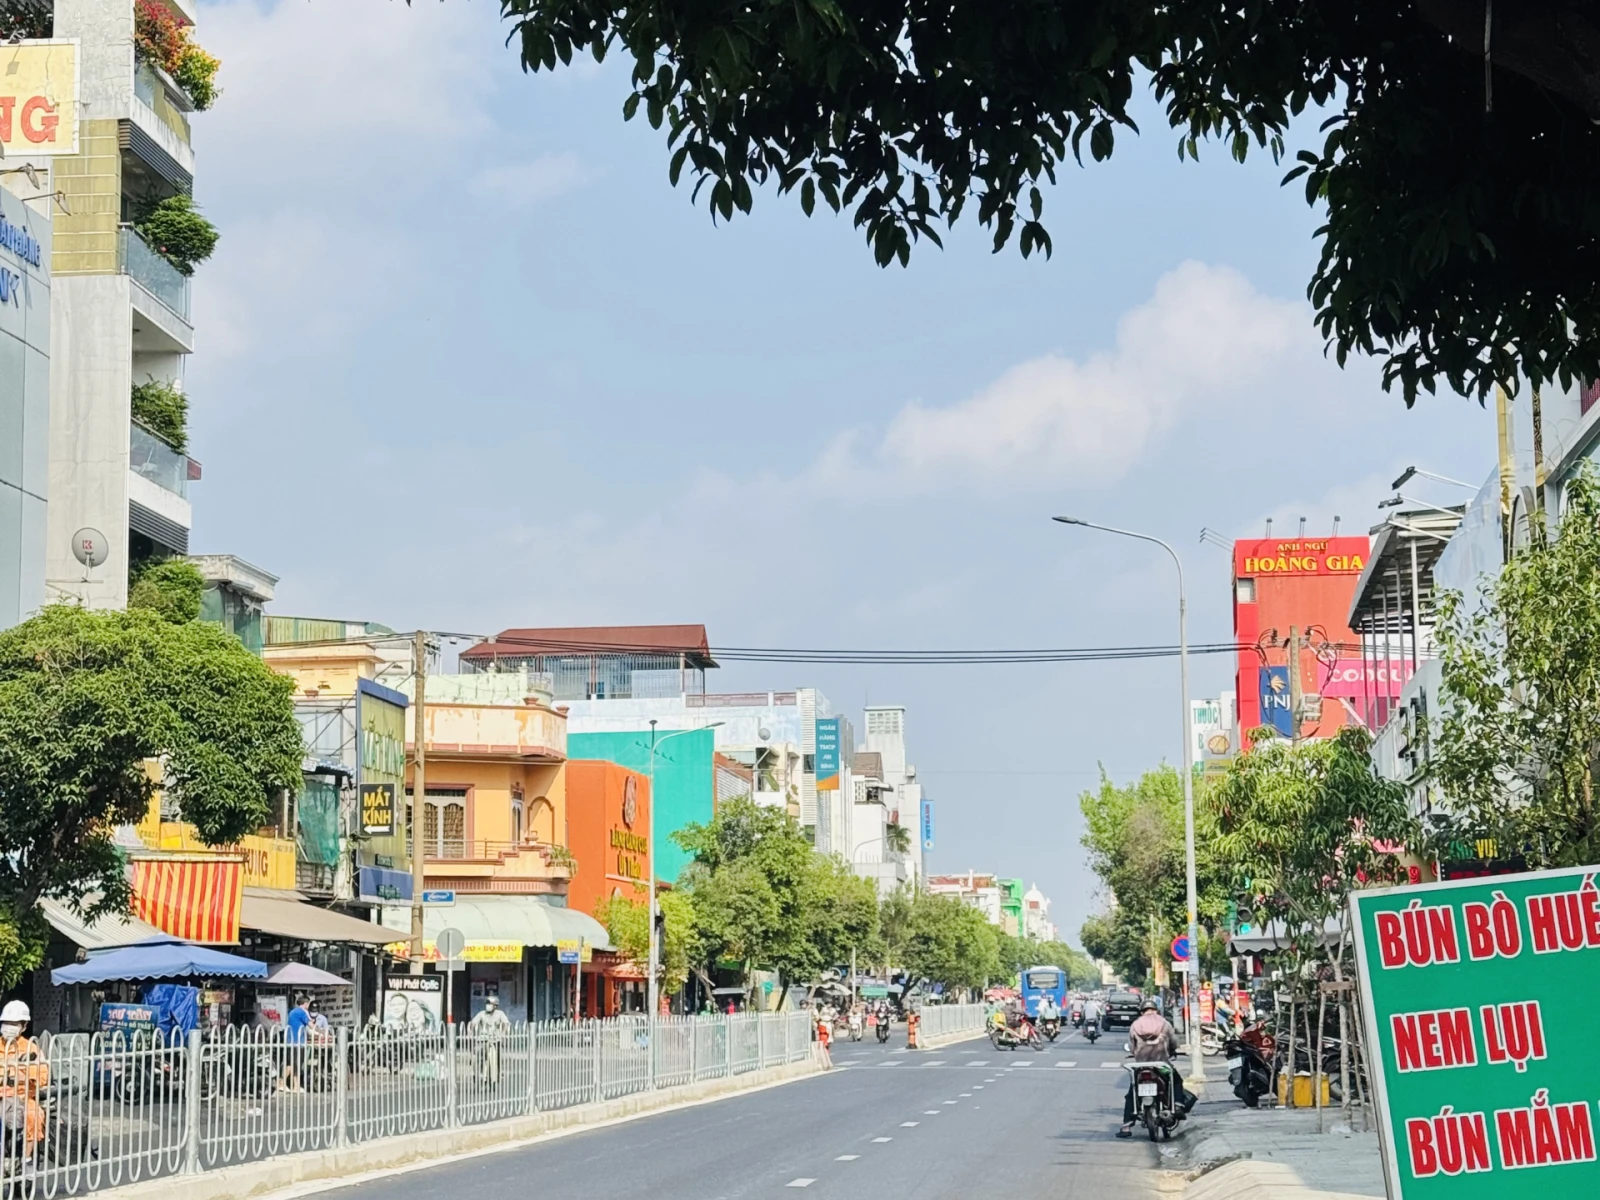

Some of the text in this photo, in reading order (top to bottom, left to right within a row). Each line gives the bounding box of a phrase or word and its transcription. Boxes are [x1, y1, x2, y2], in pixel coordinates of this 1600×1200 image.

[1277, 542, 1300, 552] ANH
[1245, 553, 1364, 573] HOÀNG GIA
[1262, 694, 1291, 711] PNJ
[363, 785, 391, 807] MẮT
[363, 807, 391, 826] KÍNH
[1375, 873, 1600, 969] BÚN BÒ HUẾ
[1390, 1000, 1547, 1073] NEM LỤI
[1405, 1087, 1597, 1178] BÚN MẮM
